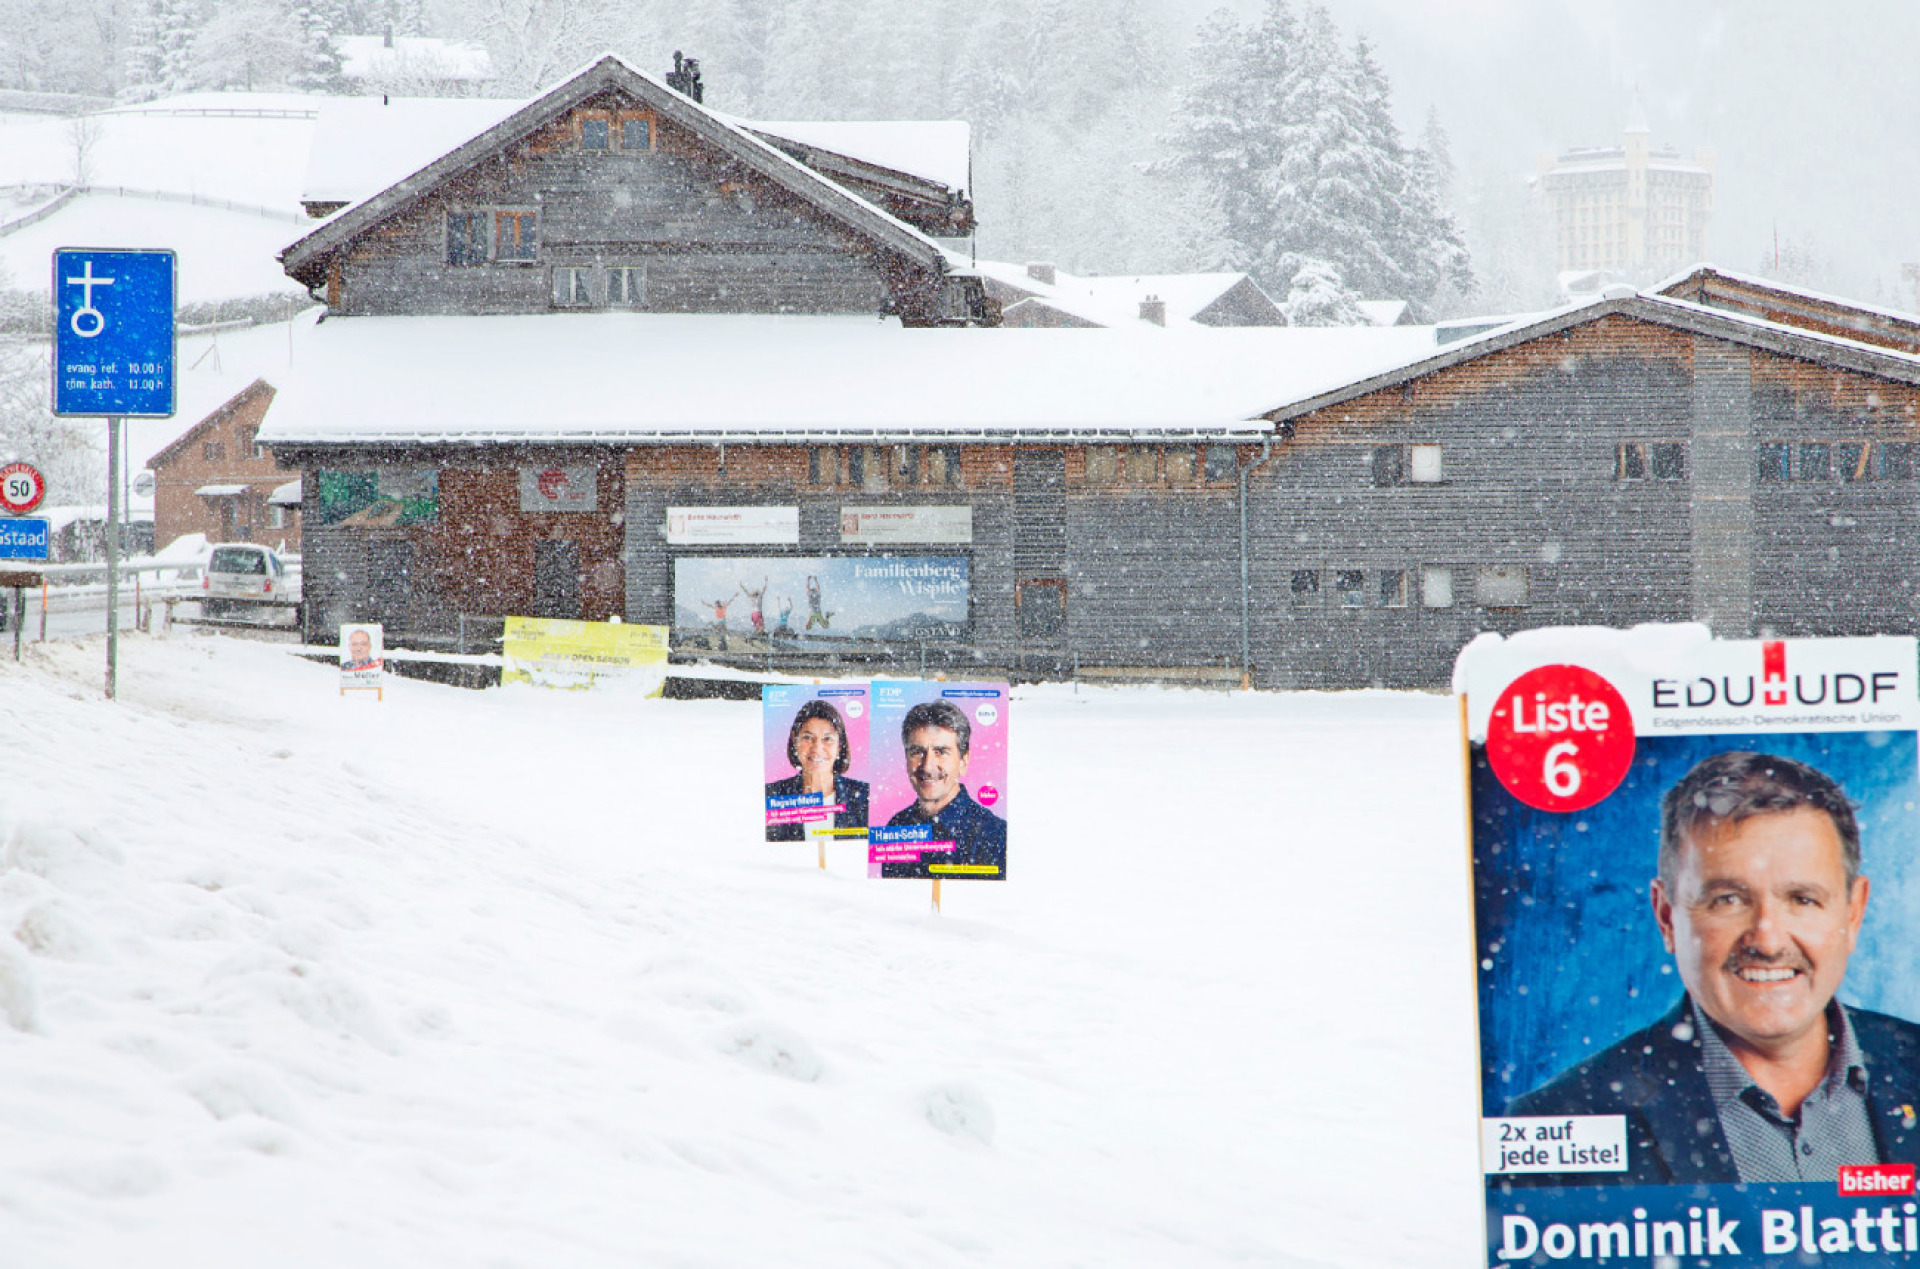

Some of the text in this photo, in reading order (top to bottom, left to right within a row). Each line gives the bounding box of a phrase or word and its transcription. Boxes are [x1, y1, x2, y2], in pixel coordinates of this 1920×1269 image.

[129, 363, 154, 374] 10.00
[90, 377, 115, 389] kath.
[129, 379, 154, 390] 11.00
[9, 480, 29, 497] 50
[854, 563, 961, 581] Familienberg
[899, 580, 960, 600] Wispile
[879, 687, 902, 697] FDP
[1653, 676, 1754, 708] EDU
[1795, 672, 1899, 705] UDF
[1512, 692, 1610, 734] Liste
[1861, 712, 1901, 724] Union
[1543, 742, 1581, 797] 6
[1500, 1121, 1573, 1141] 2x auf
[1499, 1144, 1620, 1170] jede Liste!
[1842, 1171, 1911, 1192] bisher
[1500, 1203, 1919, 1261] Dominik Blatti
